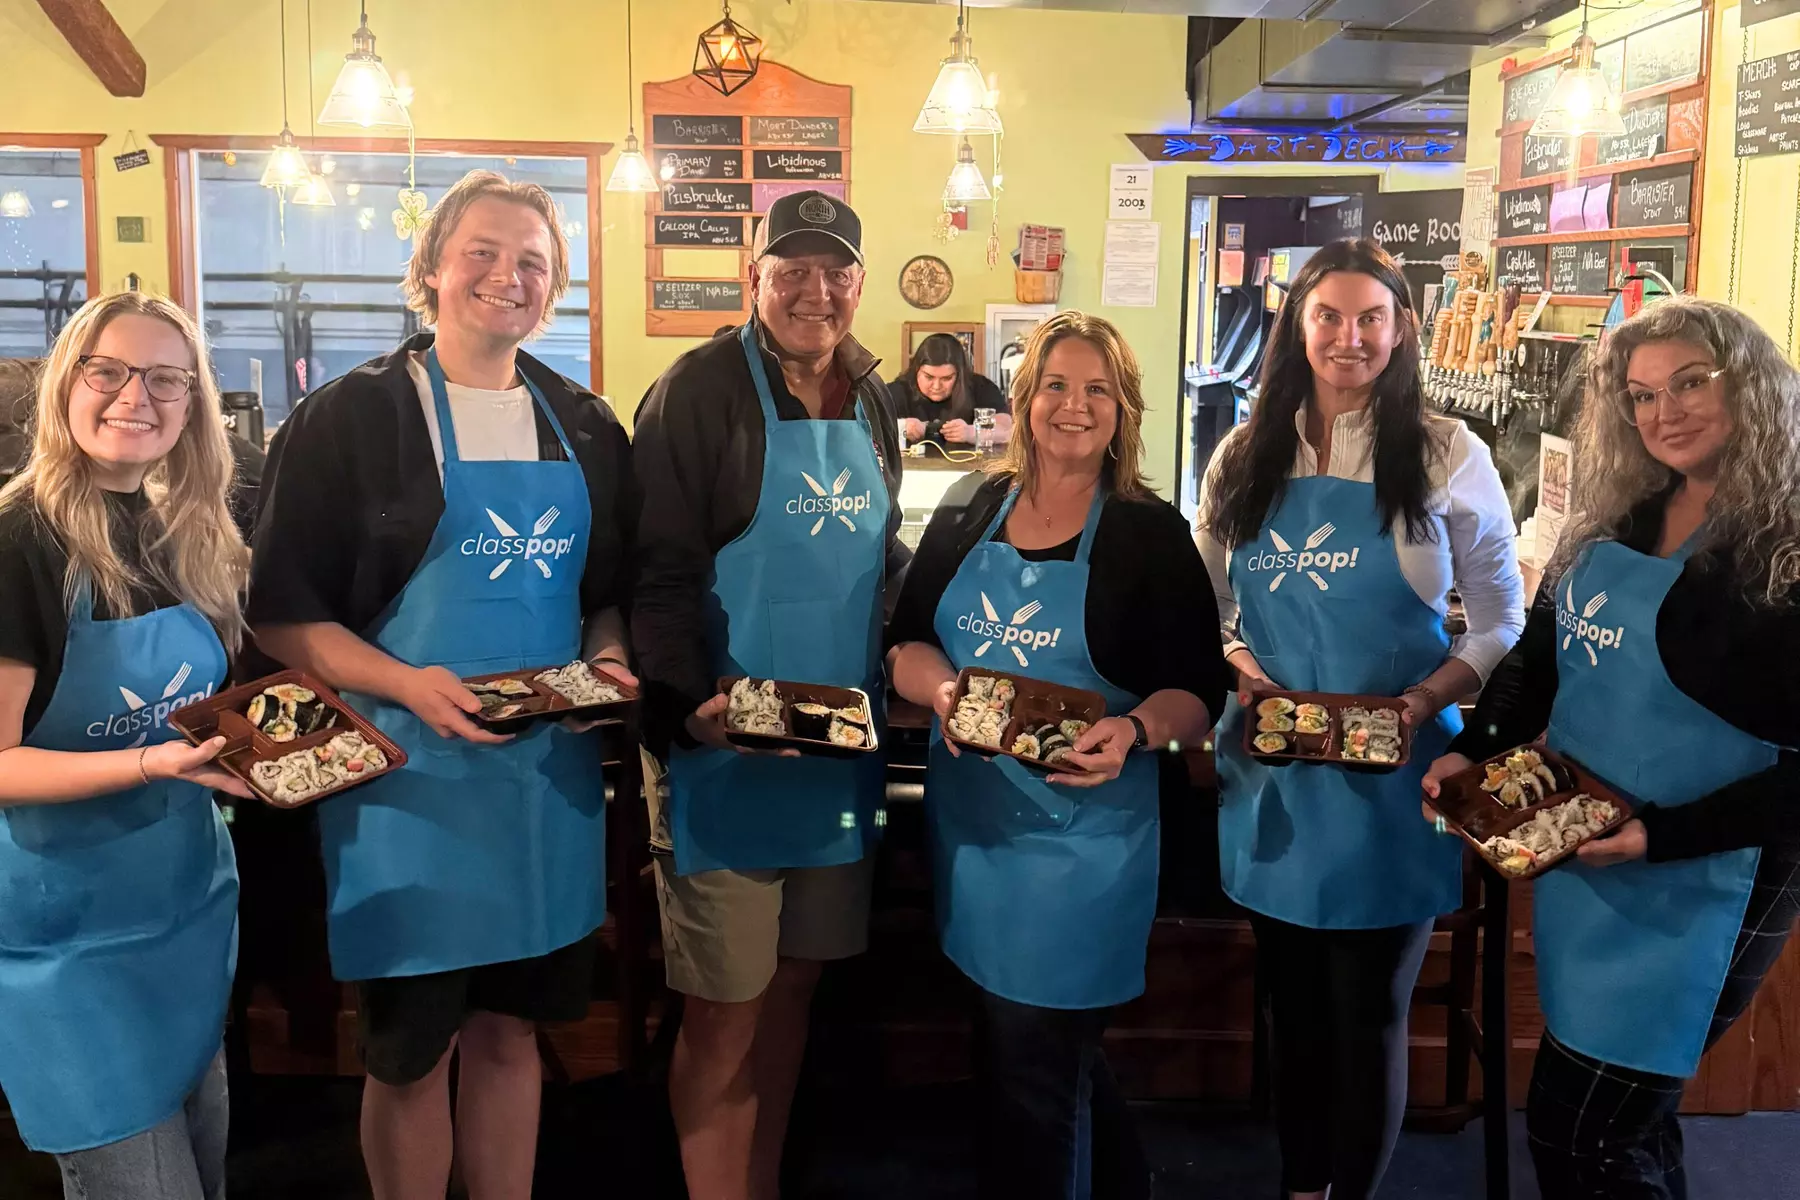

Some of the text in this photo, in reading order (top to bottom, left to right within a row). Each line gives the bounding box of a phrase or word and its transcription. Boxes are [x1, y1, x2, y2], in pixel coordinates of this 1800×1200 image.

[766, 153, 827, 168] Libidinous
[1126, 175, 1137, 184] 21
[683, 232, 700, 240] IPA
[1373, 218, 1462, 247] Game Roo
[785, 490, 871, 517] classpop!
[460, 532, 576, 560] classpop!
[1247, 547, 1360, 573] classpop!
[957, 611, 1062, 651] classpop!
